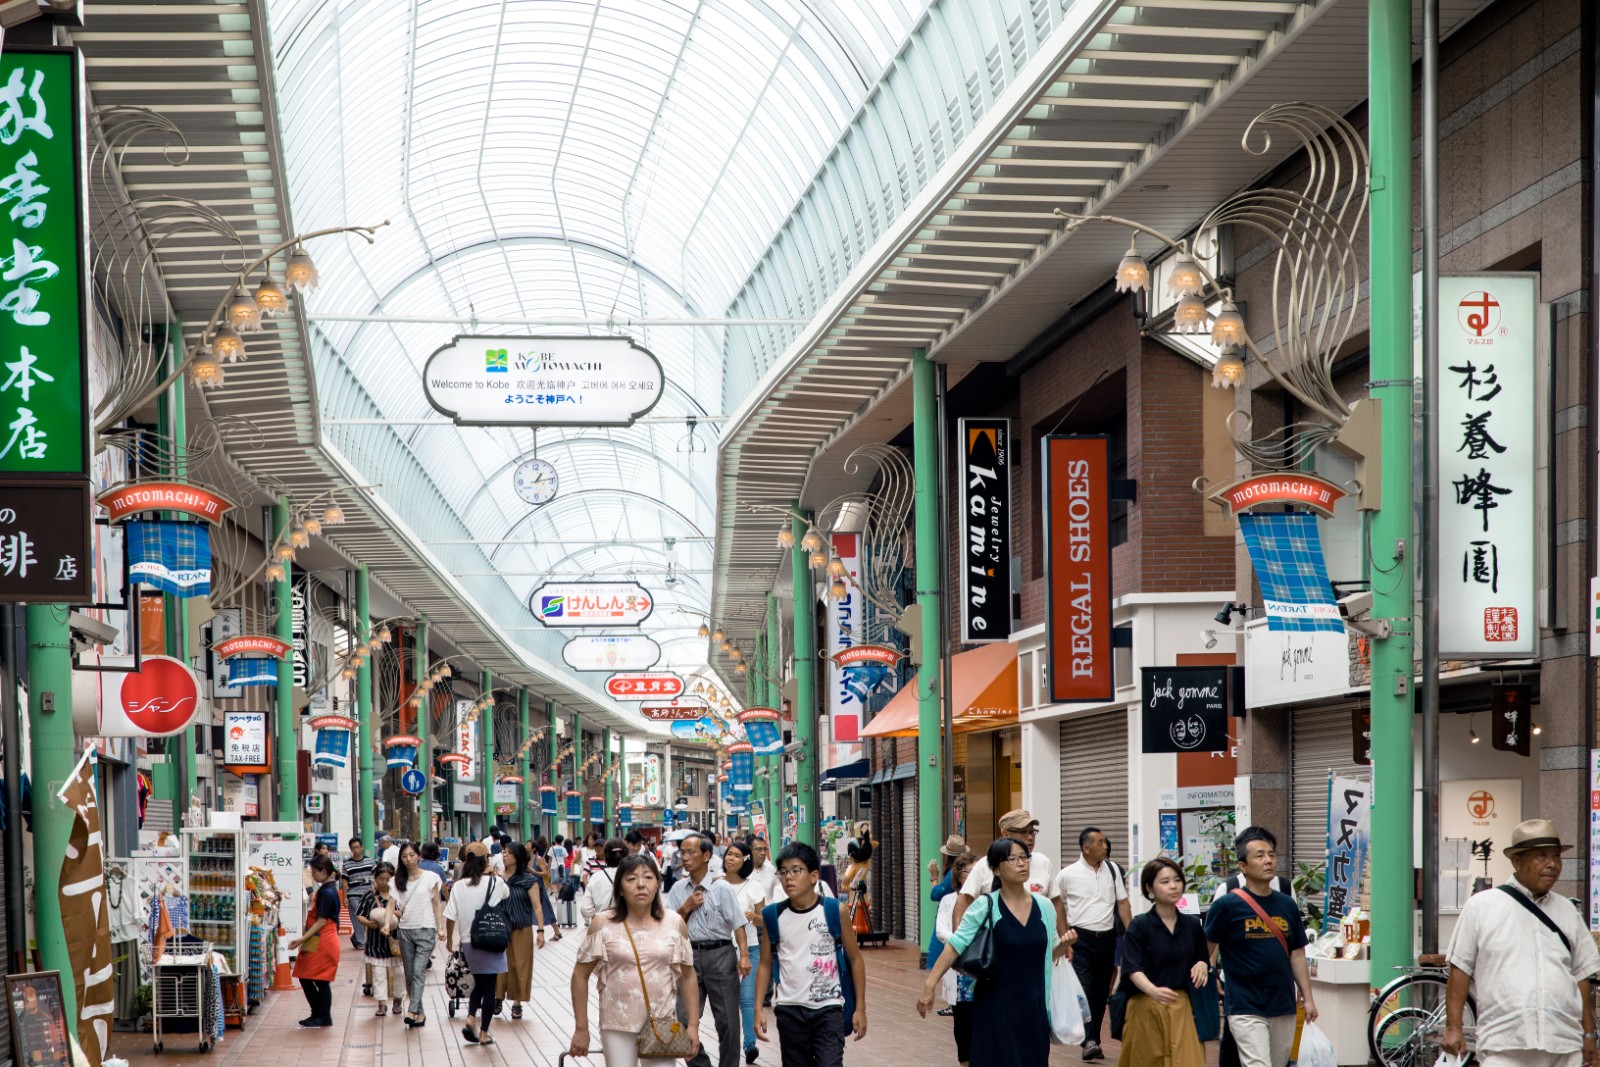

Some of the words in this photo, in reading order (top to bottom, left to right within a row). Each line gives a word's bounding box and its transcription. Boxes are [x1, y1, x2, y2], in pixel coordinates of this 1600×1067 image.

[1467, 338, 1494, 346] マルス印
[518, 351, 555, 363] KOBE
[515, 358, 602, 372] MOTOMACHI
[432, 380, 473, 389] Welcome
[475, 380, 484, 389] to
[486, 379, 510, 389] Kobe
[516, 380, 576, 390] 欢迎光临神户
[629, 380, 654, 390] 오세요
[505, 394, 583, 405] ようこそ神戸へ！
[1448, 360, 1513, 594] 杉養蜂園
[1068, 459, 1091, 563] SHOES
[990, 496, 1002, 563] Jewelry
[969, 464, 998, 631] kamine
[54, 555, 79, 581] 店
[567, 595, 625, 611] けんしん
[1071, 572, 1093, 678] REGAL
[1150, 675, 1175, 708] jack
[1178, 686, 1219, 710] gomme
[231, 743, 261, 753] 免税店
[230, 754, 261, 763] TAX-FREE
[1187, 790, 1234, 799] INFORMATION
